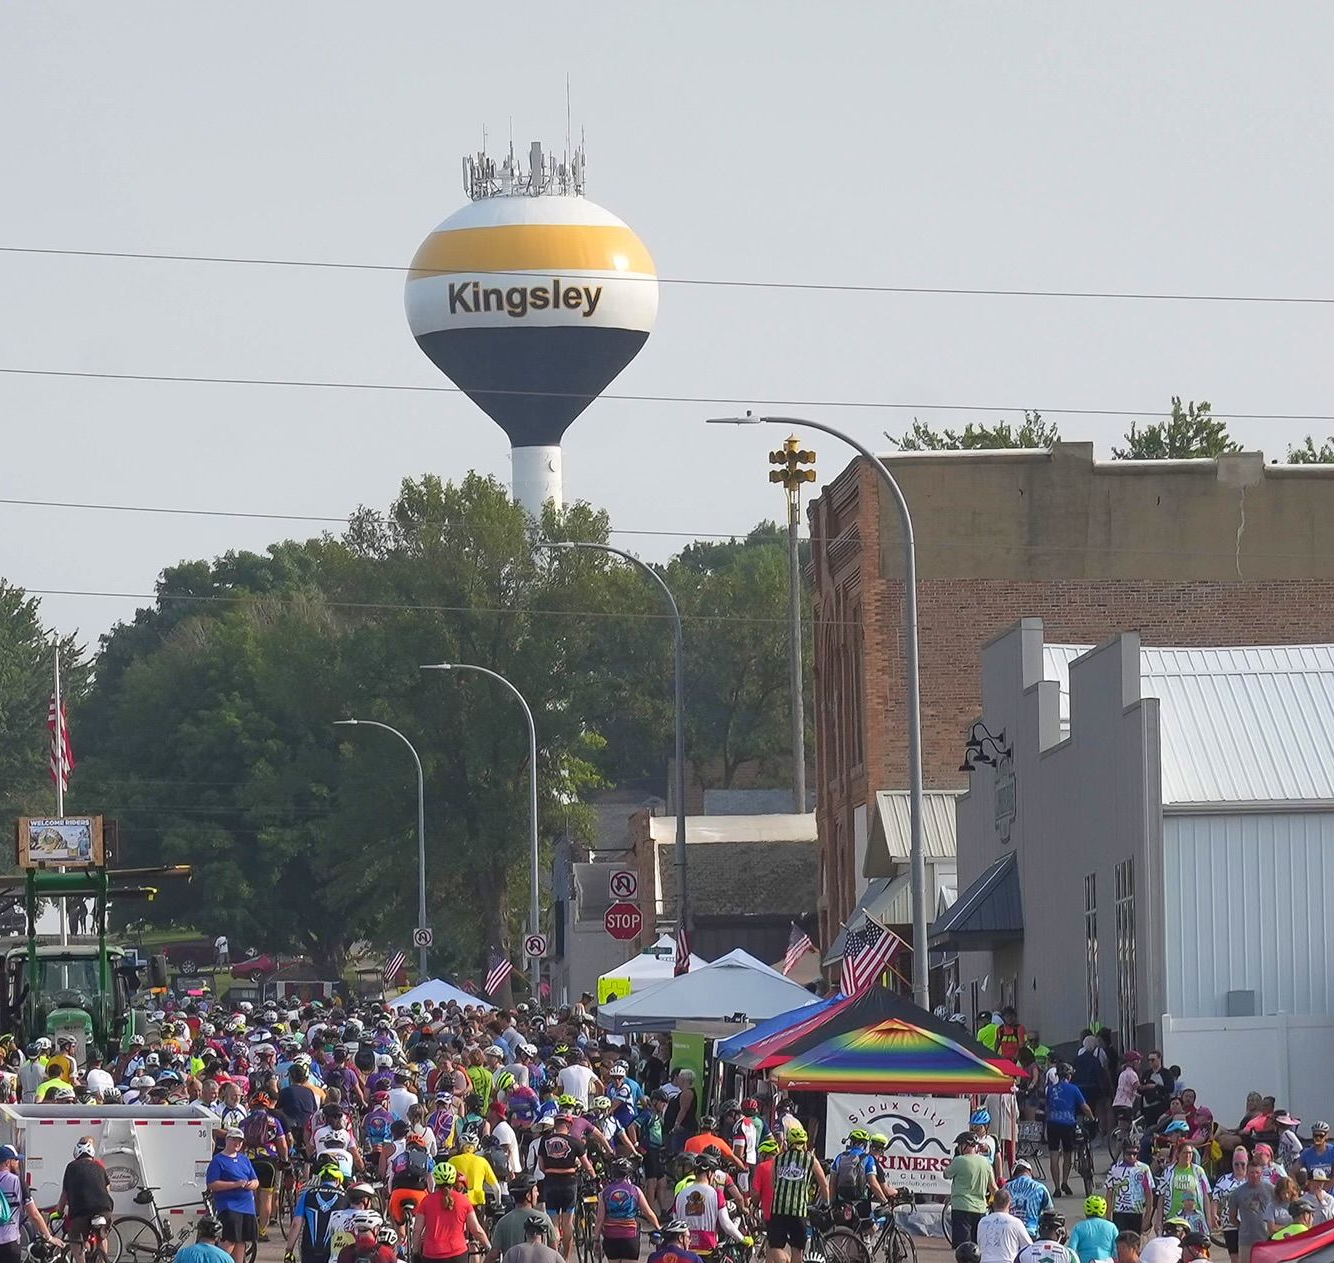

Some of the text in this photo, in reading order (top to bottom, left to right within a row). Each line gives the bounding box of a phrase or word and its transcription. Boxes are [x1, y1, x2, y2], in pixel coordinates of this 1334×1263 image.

[448, 280, 603, 318] Kingsley
[607, 914, 640, 928] STOP
[848, 1102, 945, 1128] Sioux City
[878, 1156, 951, 1171] RINERS
[900, 1172, 937, 1180] CLUB
